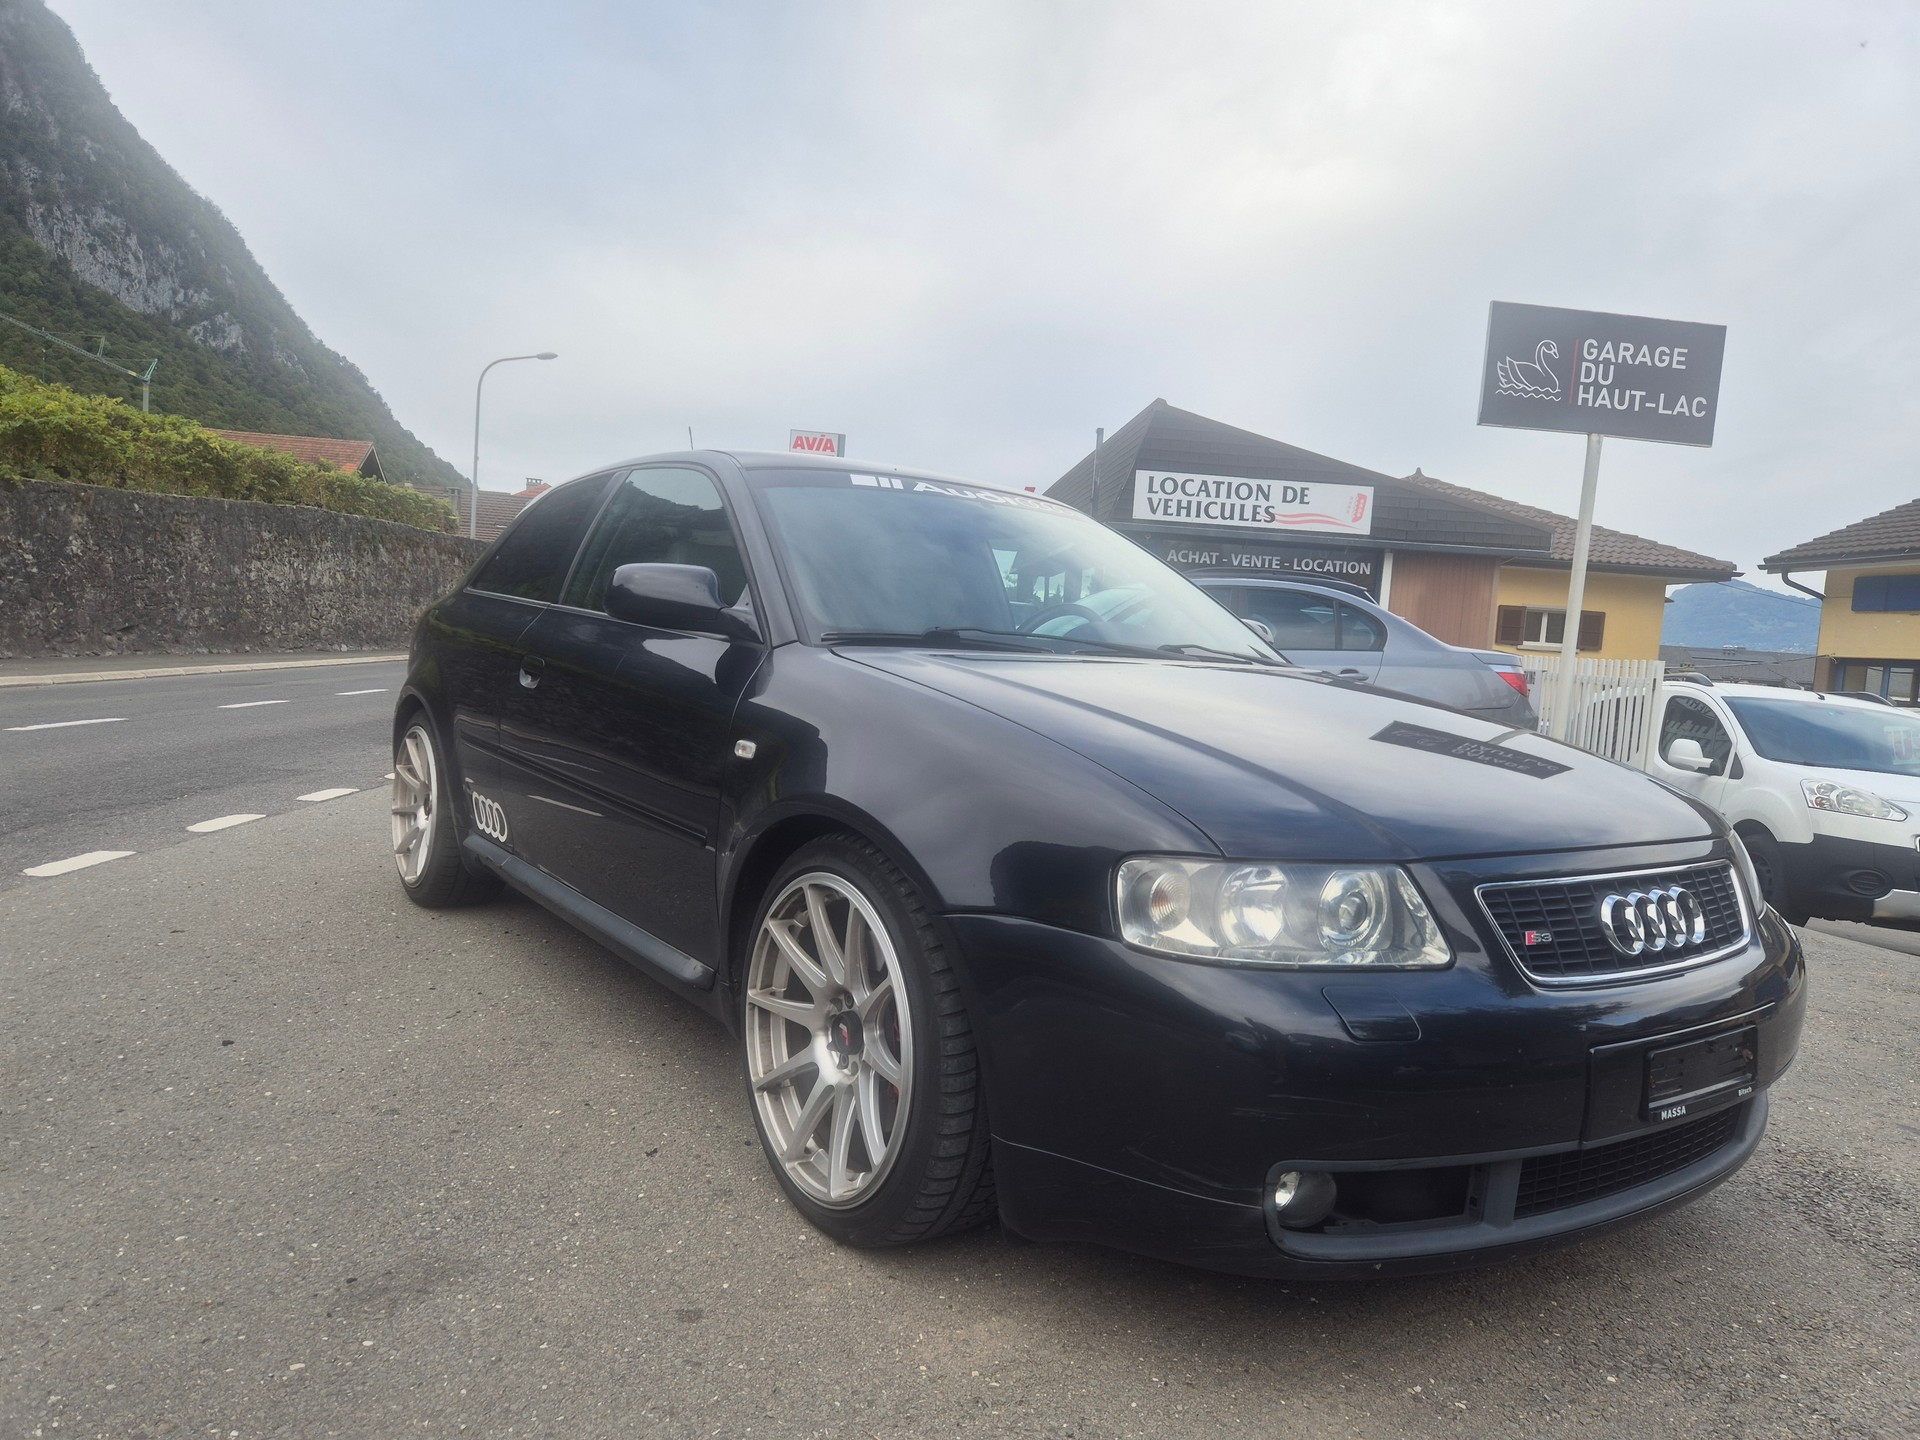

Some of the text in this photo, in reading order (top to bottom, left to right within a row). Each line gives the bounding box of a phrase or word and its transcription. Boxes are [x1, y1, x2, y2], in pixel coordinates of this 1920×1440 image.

[1582, 338, 1689, 370] GARAGE
[1580, 361, 1615, 386] DU
[1577, 384, 1708, 418] HAUT-LAC
[1147, 475, 1311, 505] LOCATION DE
[1147, 496, 1276, 524] VEHICULES
[1166, 549, 1220, 566] ACHAT
[1231, 553, 1281, 569] VENTE
[1293, 557, 1371, 575] LOCATION
[1531, 932, 1553, 943] S3
[1661, 1105, 1686, 1121] MASSA
